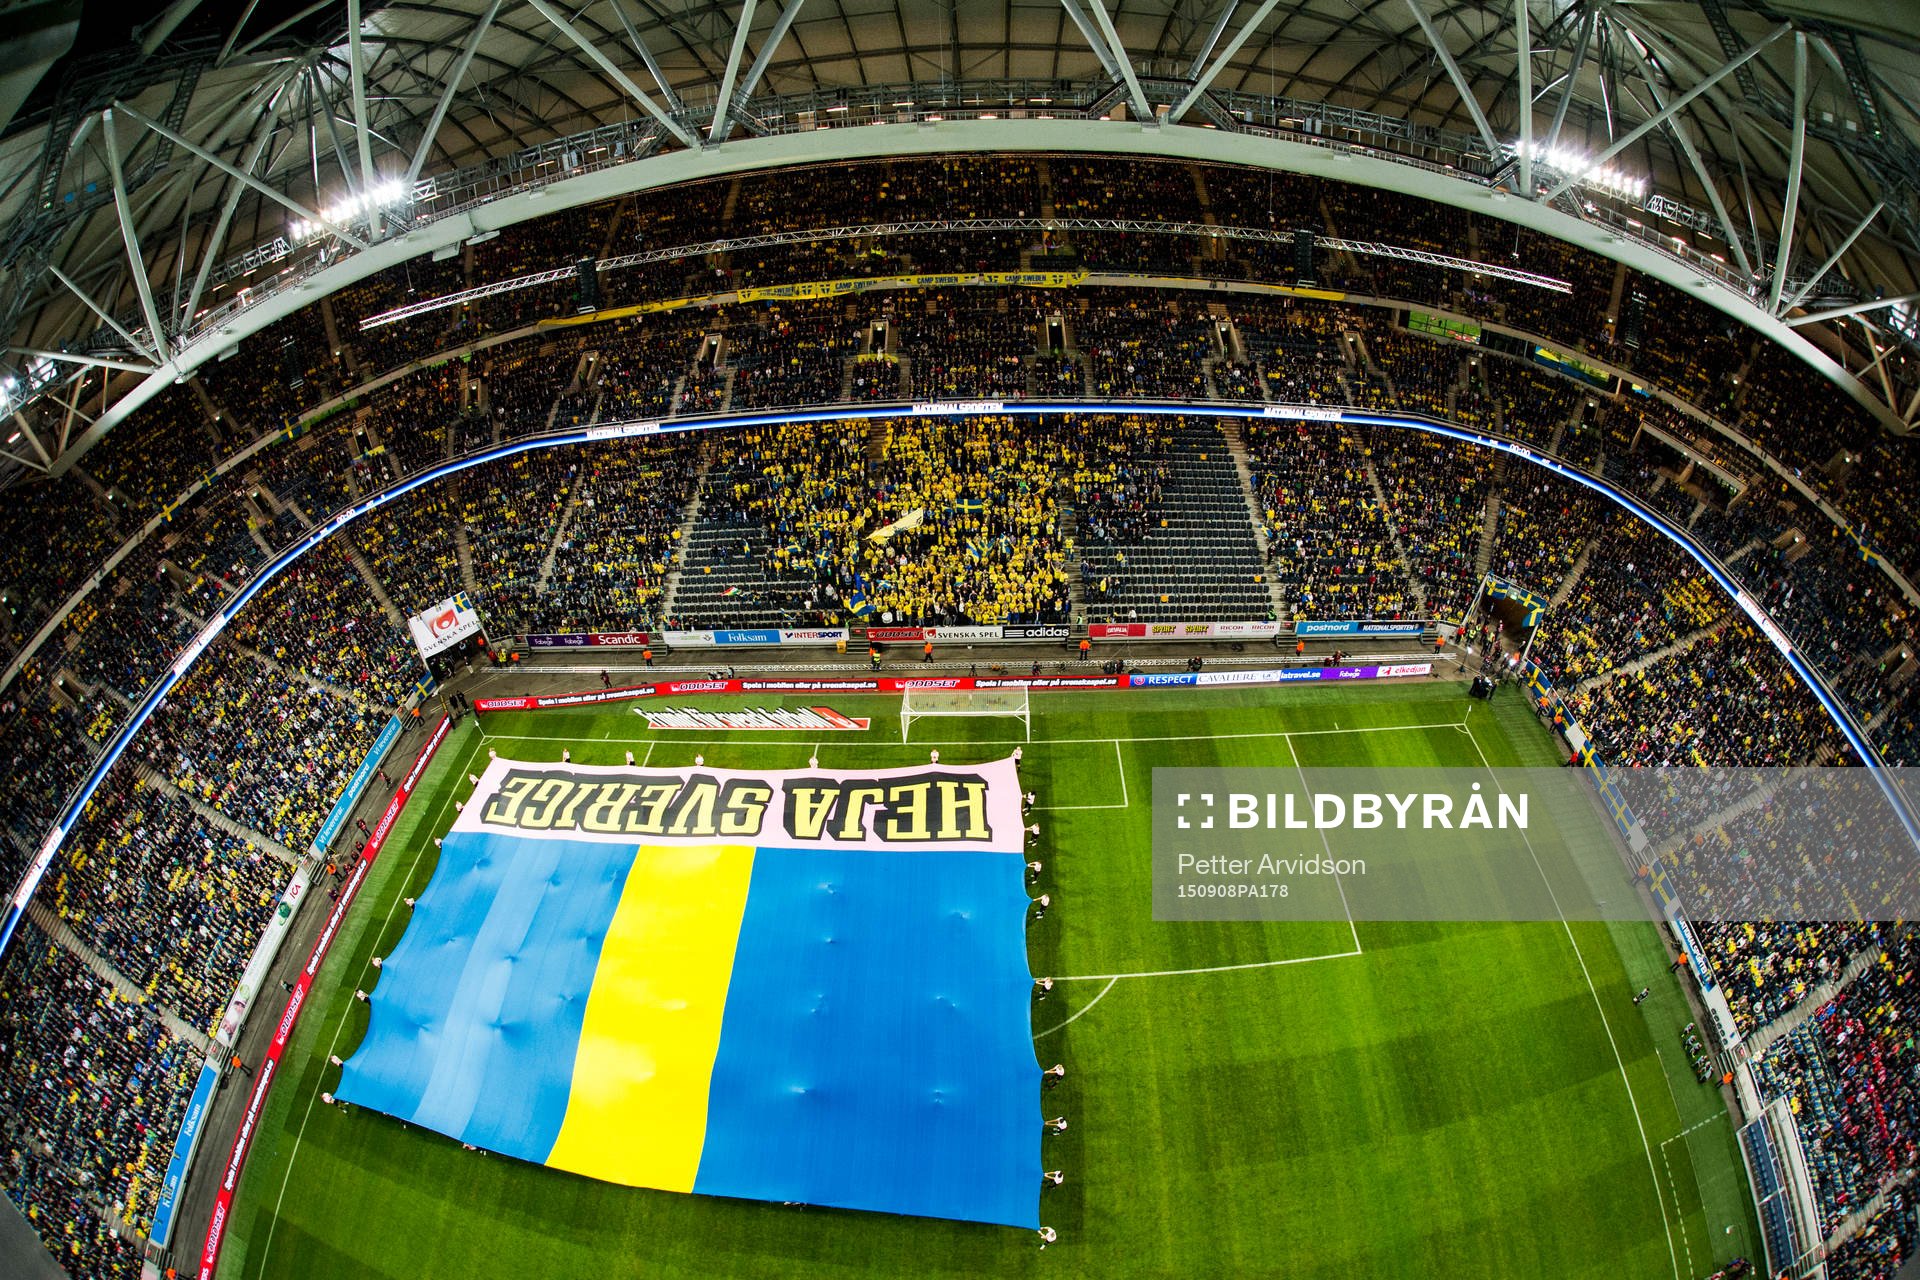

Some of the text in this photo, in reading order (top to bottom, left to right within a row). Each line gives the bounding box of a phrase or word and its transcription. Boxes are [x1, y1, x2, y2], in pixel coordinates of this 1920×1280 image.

[935, 275, 958, 284] SWEDEN
[913, 403, 1003, 415] NATIONALSPORTEN
[1026, 628, 1070, 638] adidas
[1152, 625, 1176, 633] SPORT
[1185, 625, 1209, 633] SPORT
[1307, 623, 1349, 633] postnord
[728, 633, 767, 642] Folksam
[876, 630, 923, 638] ODDSET
[424, 631, 457, 653] SVENSKA
[598, 634, 641, 645] Scandic
[1149, 676, 1193, 685] RESPECT
[1199, 673, 1257, 683] CAVALIERE
[680, 682, 728, 690] ODDSET
[906, 680, 960, 688] ODDSET
[487, 699, 526, 709] ODDSET
[348, 763, 370, 798] postnord
[480, 769, 993, 842] HEJA SVERIGE
[376, 798, 399, 842] ODDSET
[290, 884, 301, 900] ICA
[281, 984, 304, 1037] ODDSET
[184, 1103, 201, 1137] Folksam
[207, 1200, 225, 1256] ODDSET
